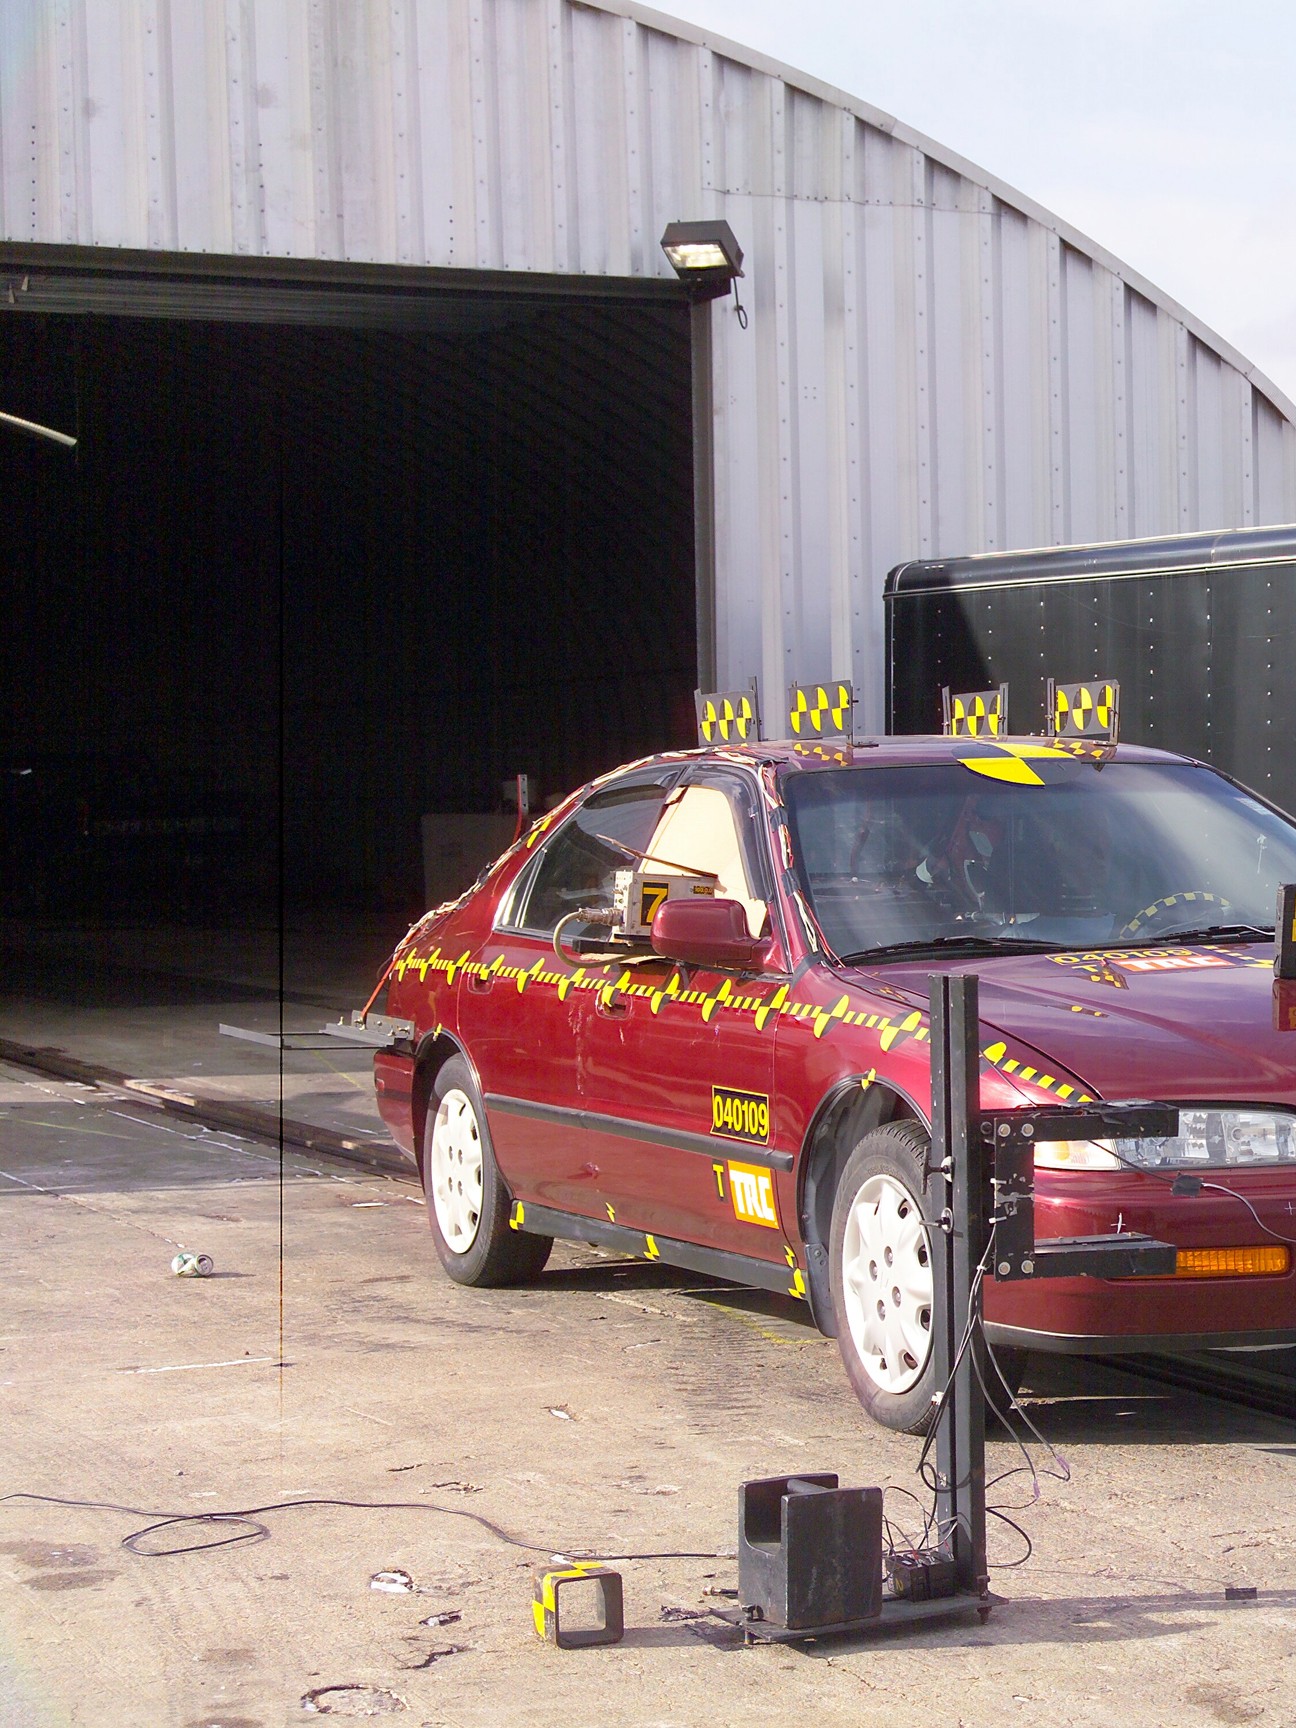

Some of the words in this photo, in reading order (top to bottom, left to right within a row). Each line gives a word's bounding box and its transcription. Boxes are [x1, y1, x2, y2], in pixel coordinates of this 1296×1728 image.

[642, 887, 669, 923] 7
[1053, 949, 1193, 965] 040109
[1118, 956, 1227, 971] TRC
[713, 1094, 769, 1137] 040109
[712, 1163, 725, 1198] T
[729, 1169, 775, 1222] TRC
